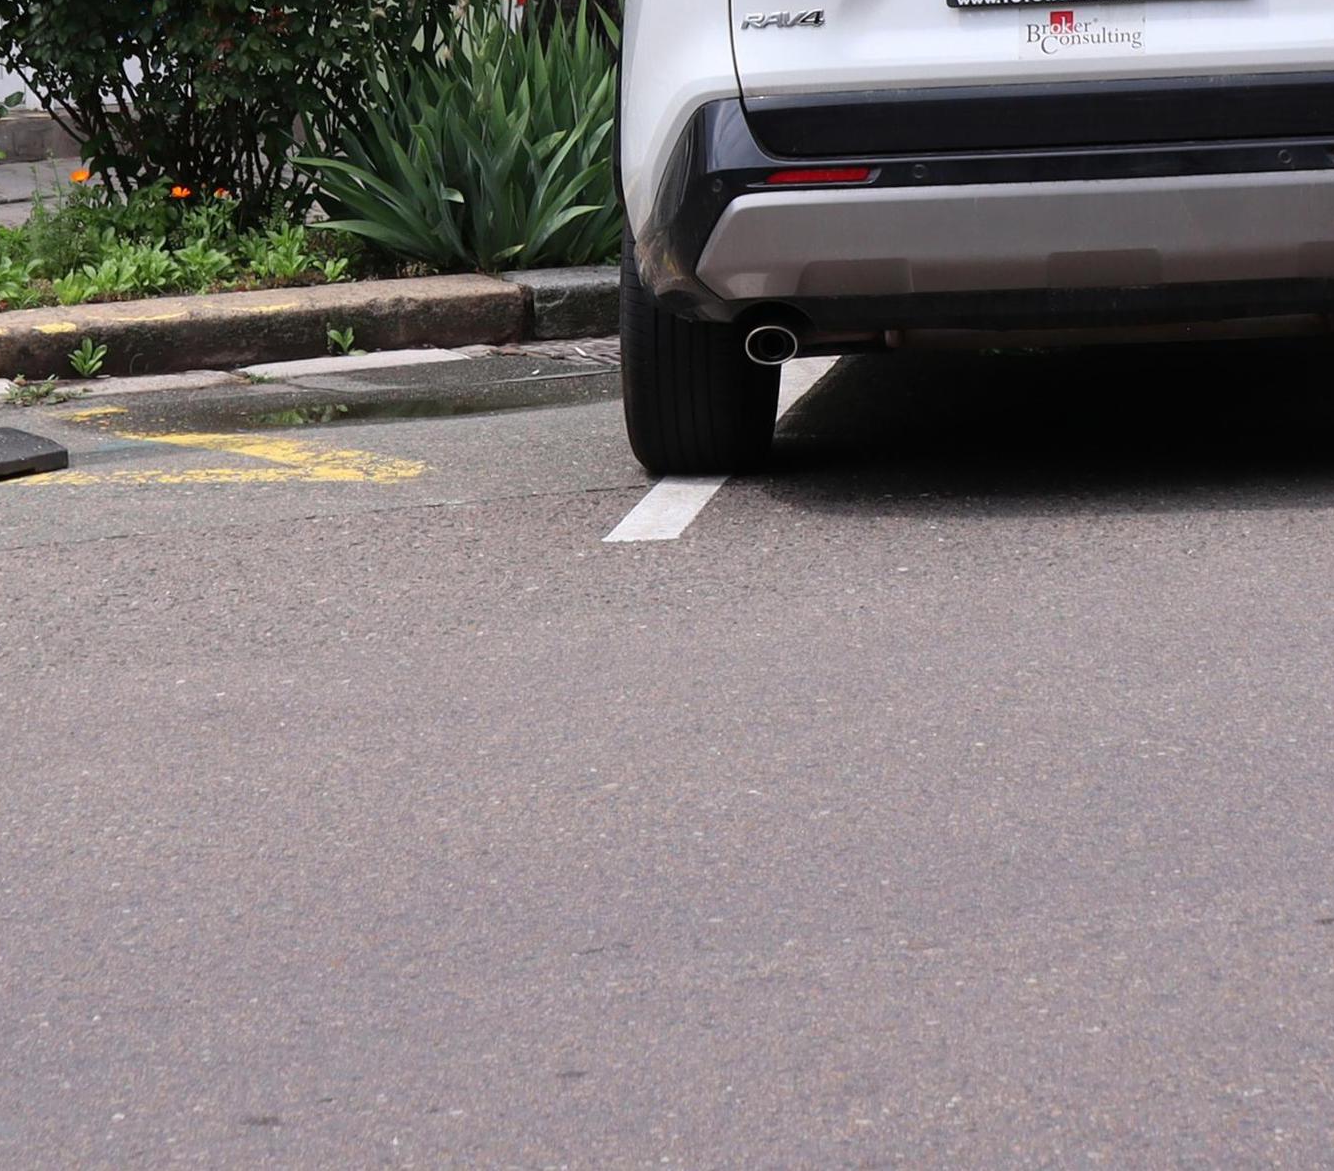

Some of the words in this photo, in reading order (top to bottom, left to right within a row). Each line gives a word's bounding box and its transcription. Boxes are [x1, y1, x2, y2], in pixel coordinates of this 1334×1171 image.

[741, 9, 825, 29] RAV4
[1026, 17, 1091, 44] Broker
[1041, 28, 1142, 55] Consulting
